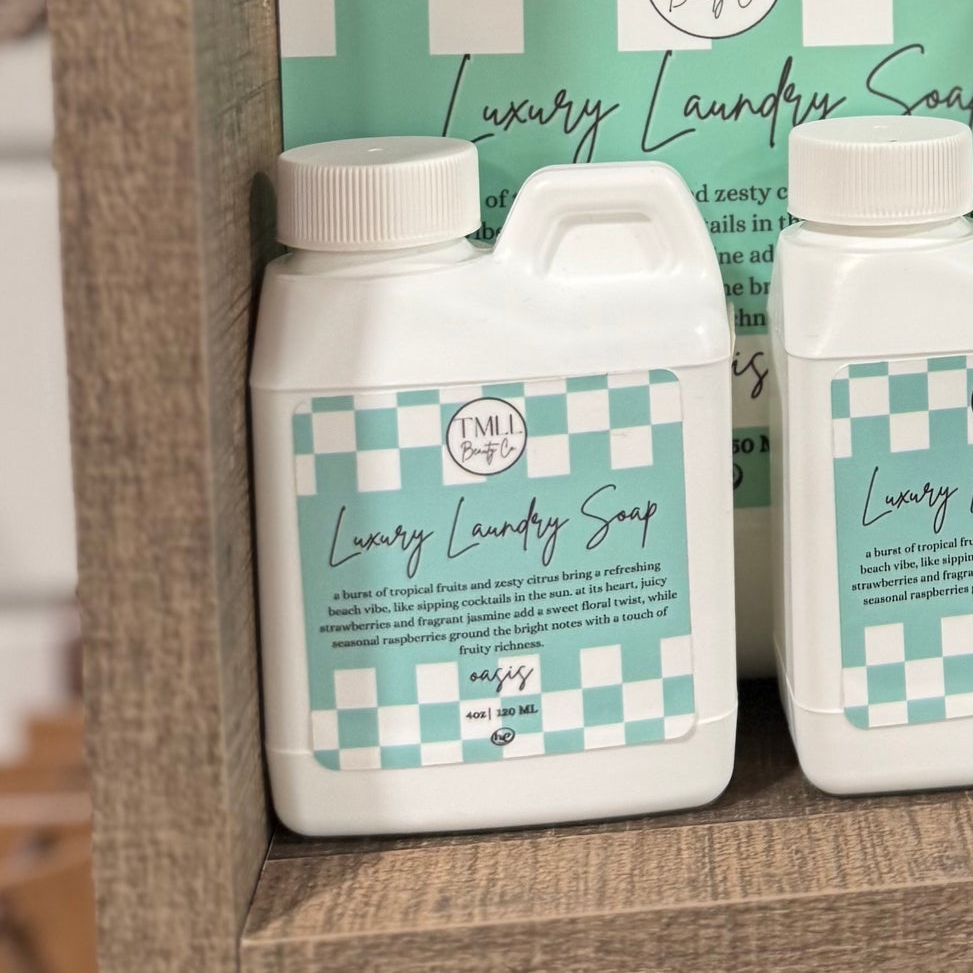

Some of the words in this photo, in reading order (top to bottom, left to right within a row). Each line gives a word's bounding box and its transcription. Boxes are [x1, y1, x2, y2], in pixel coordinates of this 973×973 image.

[441, 52, 620, 163] Luxury
[641, 49, 847, 151] Laundry
[485, 189, 509, 209] of
[713, 183, 772, 206] zesty
[751, 213, 772, 232] in
[453, 413, 523, 436] TMLL
[862, 466, 959, 534] Luxury
[329, 505, 434, 578] Luxury
[447, 497, 570, 566] Laundry
[581, 484, 658, 550] Soap
[874, 545, 901, 557] burst
[918, 537, 957, 553] tropical
[860, 560, 891, 574] beach
[893, 558, 918, 571] vibe,
[921, 556, 939, 568] like
[389, 582, 434, 599] tropical
[436, 580, 468, 593] fruits
[470, 577, 492, 590] and
[494, 576, 524, 589] zesty
[527, 573, 559, 585] citrus
[562, 568, 593, 582] bring
[604, 560, 661, 577] refreshing
[852, 574, 918, 591] strawberries
[920, 570, 940, 583] and
[364, 602, 391, 615] vibe,
[416, 598, 459, 613] sipping
[461, 592, 511, 607] cocktails
[549, 589, 573, 599] sun.
[605, 579, 638, 592] heart,
[641, 575, 667, 591] juicy
[863, 590, 907, 605] seasonal
[911, 584, 969, 601] raspberries
[393, 616, 415, 629] and
[417, 613, 463, 629] fragrant
[467, 609, 511, 626] jasmine
[546, 601, 579, 615] sweet
[582, 596, 611, 611] floral
[614, 593, 645, 607] twist,
[648, 588, 677, 603] while
[383, 630, 447, 647] raspberries
[449, 626, 490, 643] ground
[514, 620, 548, 636] bright
[552, 618, 582, 630] notes
[585, 612, 610, 626] with
[622, 606, 654, 622] touch
[459, 643, 491, 656] fruity
[494, 639, 544, 652] richness.
[469, 664, 535, 692] oasis
[497, 707, 516, 718] 120
[518, 703, 539, 716] ML
